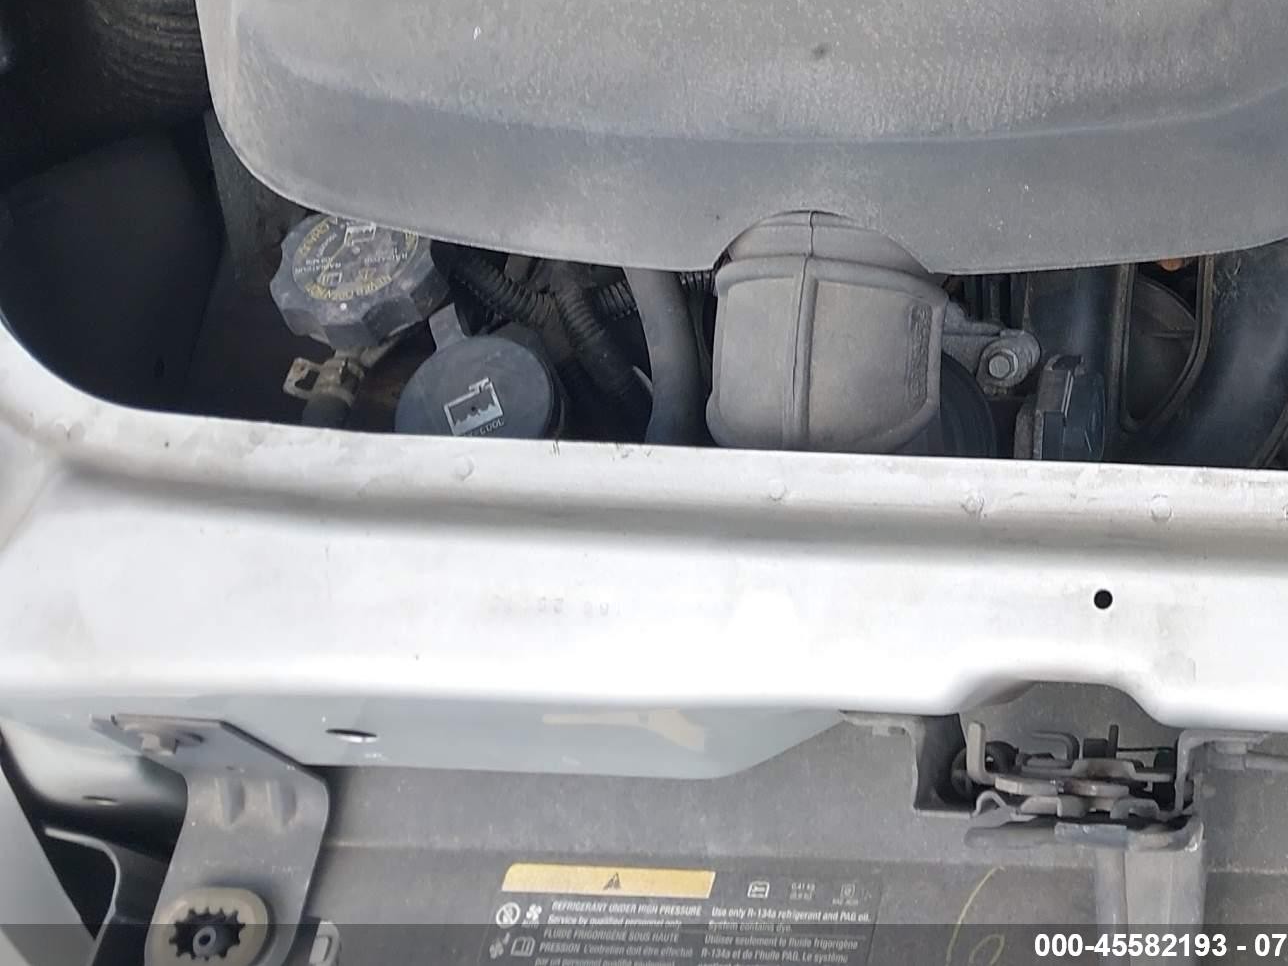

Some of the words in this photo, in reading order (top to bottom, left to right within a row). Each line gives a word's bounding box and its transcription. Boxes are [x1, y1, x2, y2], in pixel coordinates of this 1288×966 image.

[552, 901, 607, 913] REFRIGERANT
[609, 903, 636, 914] UNDER
[638, 904, 657, 914] HIGH
[659, 905, 701, 916] PRESSURE
[712, 907, 726, 916] Use
[729, 908, 745, 919] only
[747, 908, 776, 919] R-134a
[778, 910, 821, 921] refrigerant
[823, 911, 838, 921] and
[548, 914, 576, 925] Service
[740, 923, 775, 932] contains
[544, 928, 571, 939] FLUIDE
[629, 930, 650, 941] SOUS
[652, 931, 679, 942] HAUTE
[735, 936, 777, 946] seulement
[701, 948, 731, 958] R-134a
